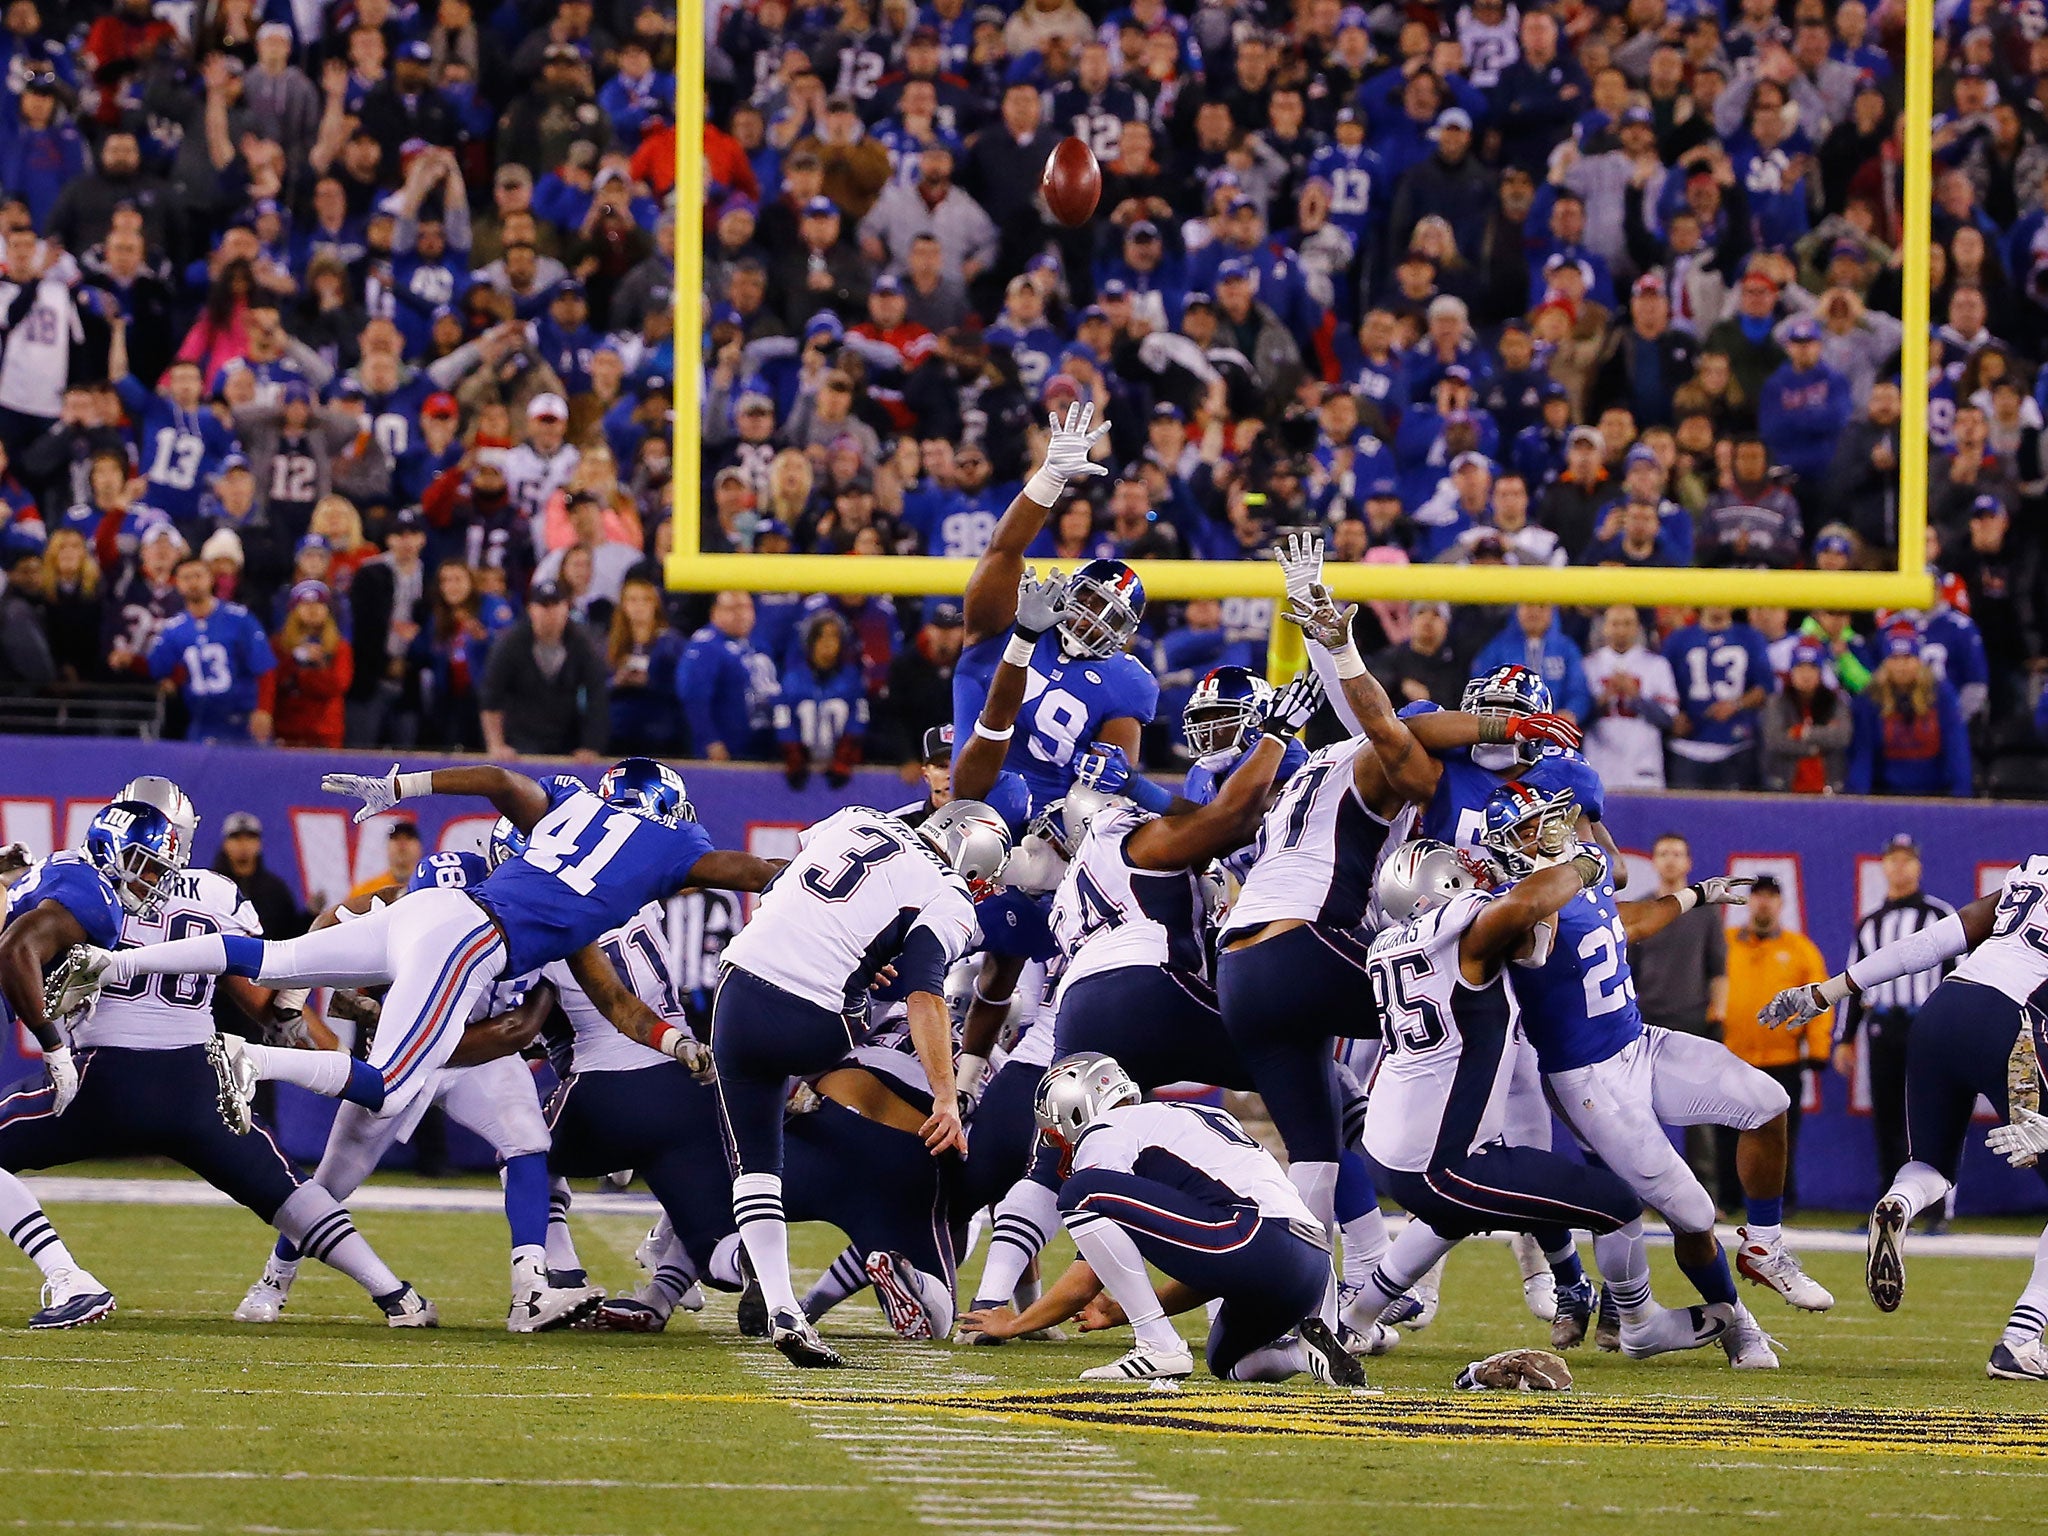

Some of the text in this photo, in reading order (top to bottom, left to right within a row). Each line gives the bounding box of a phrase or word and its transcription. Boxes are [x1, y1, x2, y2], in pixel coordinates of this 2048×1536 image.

[838, 48, 885, 99] 12
[1073, 113, 1123, 161] 12
[1331, 168, 1371, 215] 13
[149, 426, 204, 490] 13
[270, 454, 317, 502] 12
[941, 510, 1001, 557] 98
[182, 642, 232, 696] 13
[1686, 643, 1750, 702] 13
[796, 698, 850, 757] 10
[1511, 787, 1541, 809] 23
[523, 791, 642, 896] 41
[939, 817, 954, 831] 3
[428, 851, 467, 889] 98
[801, 823, 906, 904] 3
